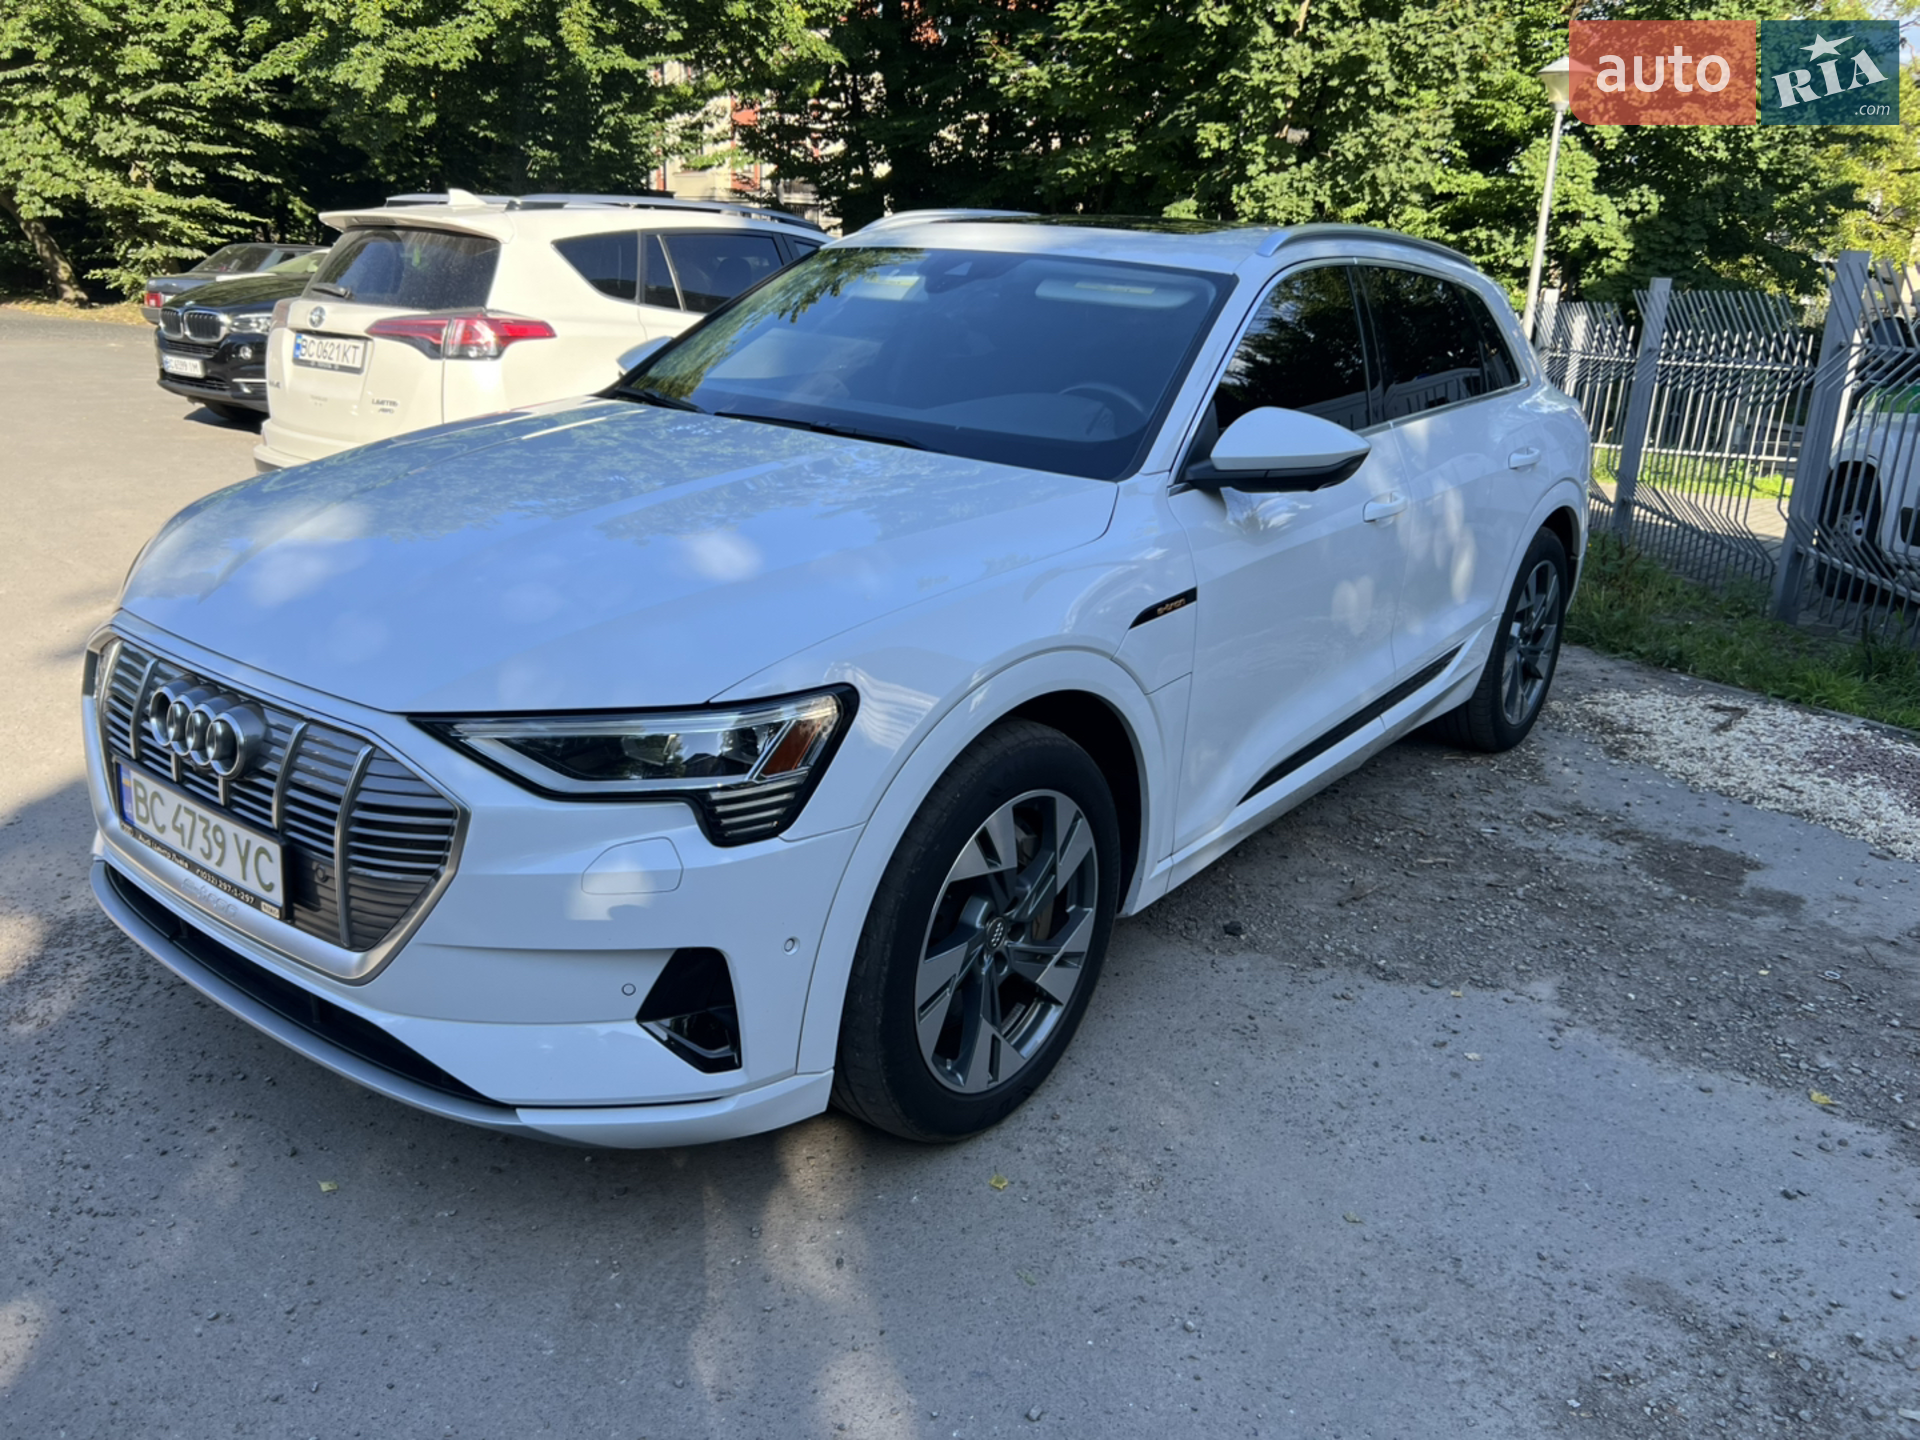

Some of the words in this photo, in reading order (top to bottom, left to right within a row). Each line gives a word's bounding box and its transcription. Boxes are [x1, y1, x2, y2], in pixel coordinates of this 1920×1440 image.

[132, 778, 166, 835] BC
[171, 803, 226, 867] 4739
[233, 832, 274, 893] YC
